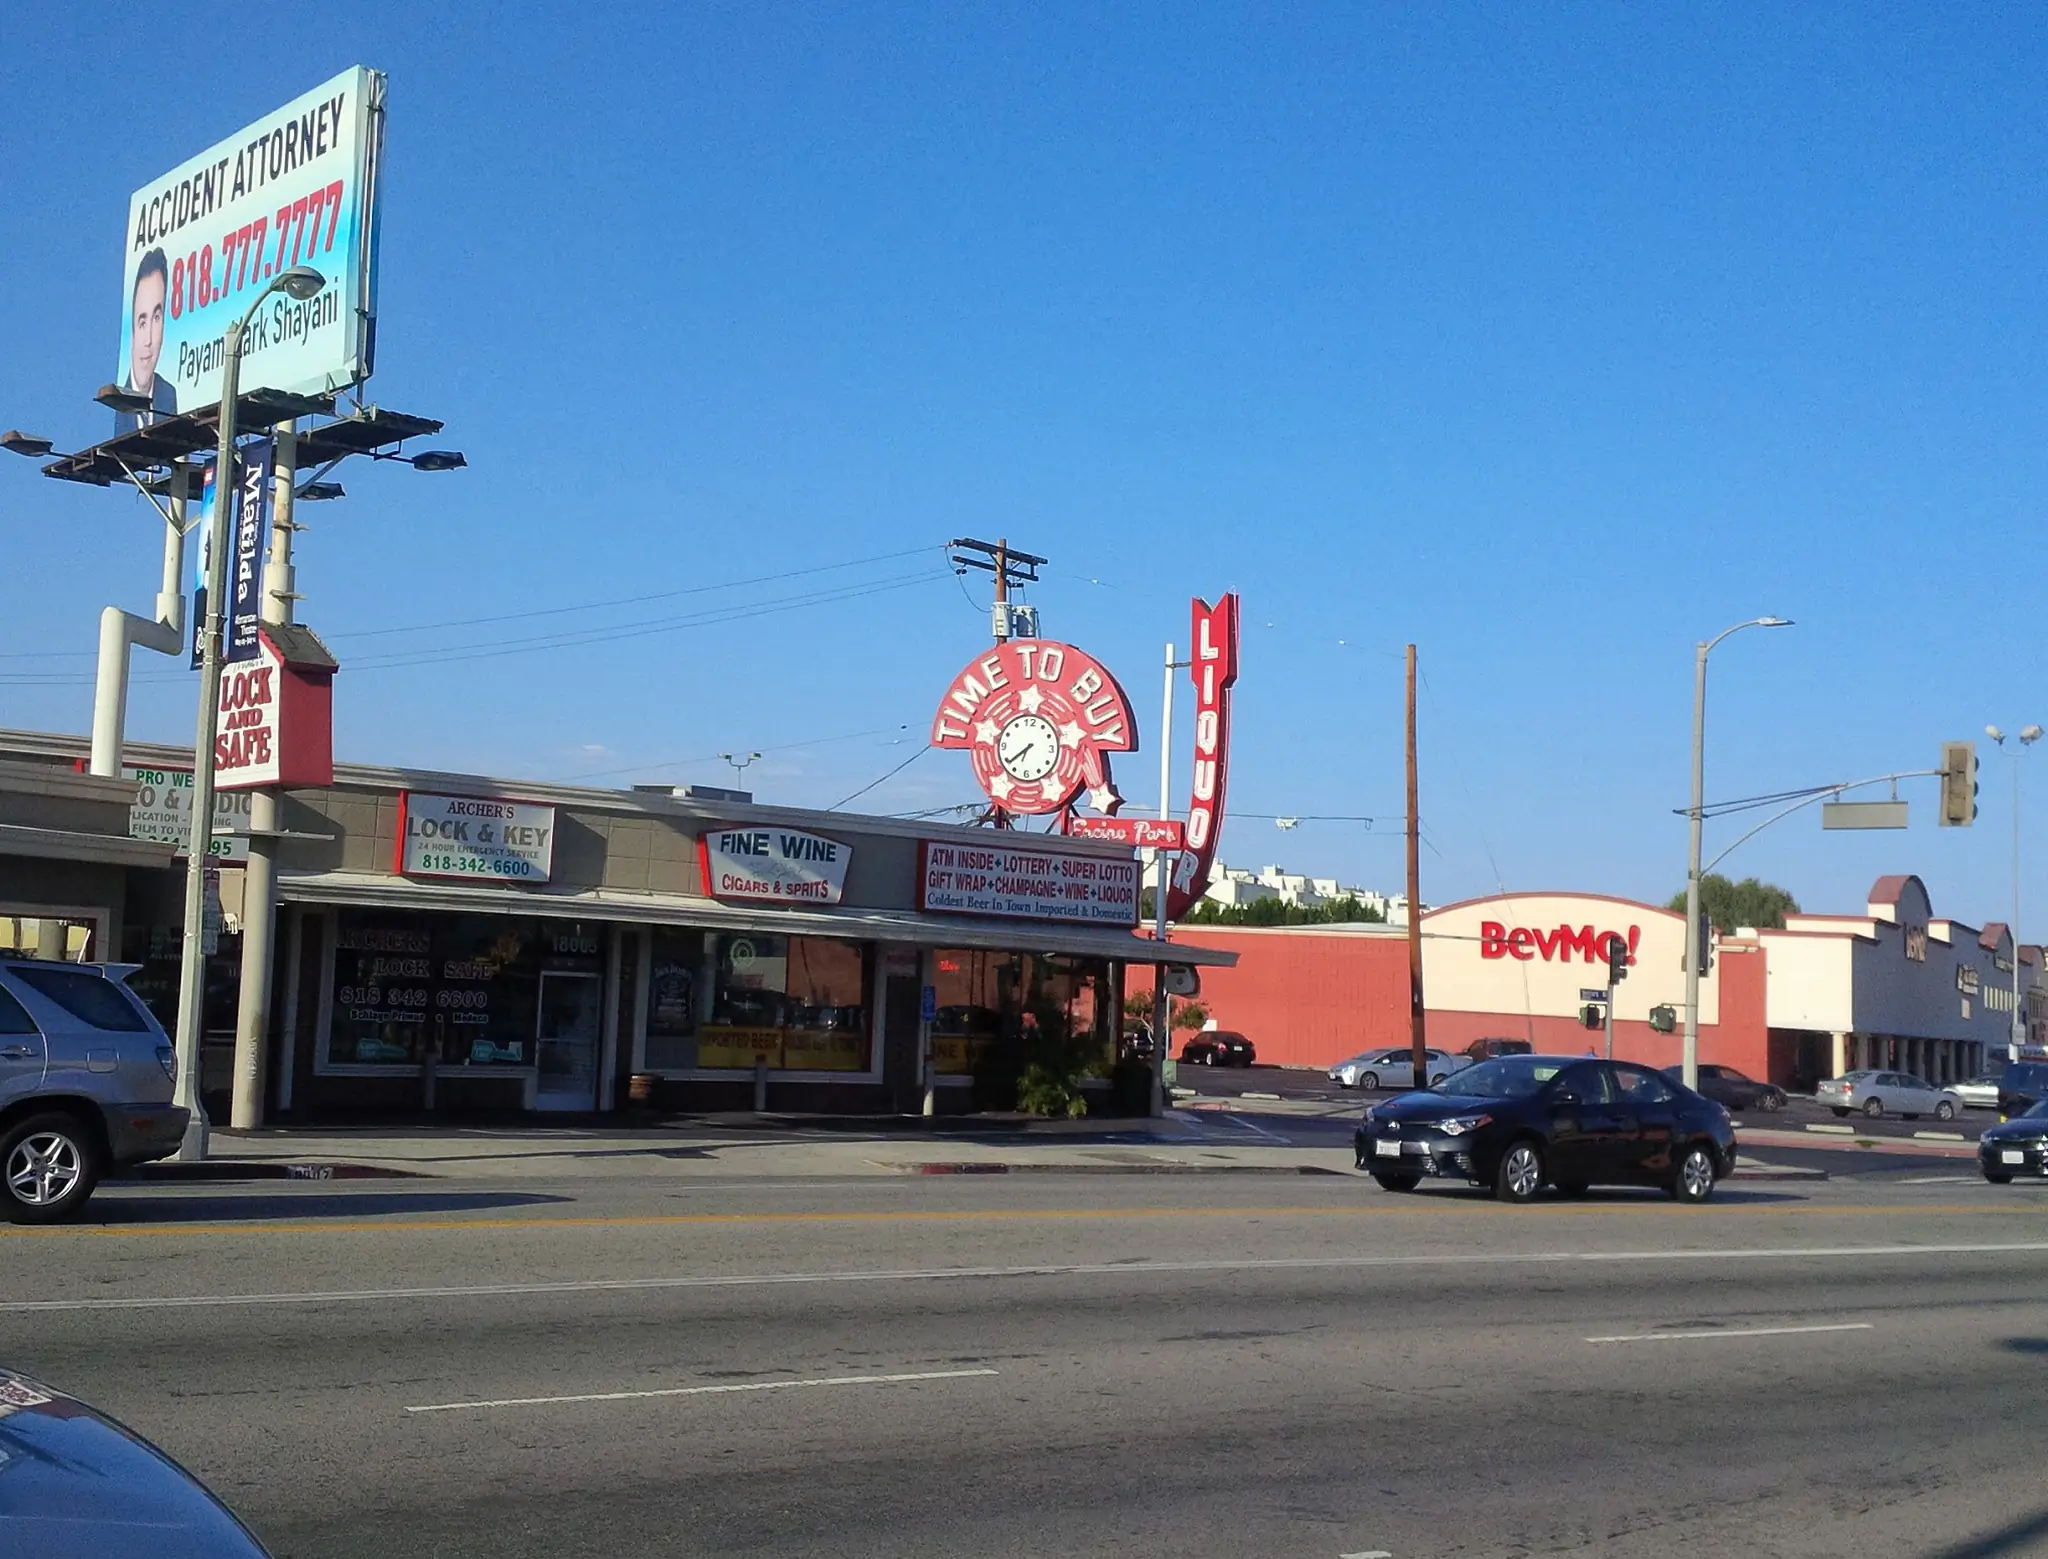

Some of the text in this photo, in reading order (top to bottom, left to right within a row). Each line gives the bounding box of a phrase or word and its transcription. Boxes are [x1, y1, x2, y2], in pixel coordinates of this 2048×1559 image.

[134, 92, 345, 251] ACCIDENT ATTORNEY
[170, 180, 344, 321] 818.777.7777
[177, 335, 225, 388] Payam
[273, 276, 339, 346] Shayani
[237, 463, 263, 604] Matilda
[220, 666, 273, 712] LOCK
[936, 645, 1125, 746] TIME TO BUY
[225, 708, 264, 730] AND
[1024, 718, 1036, 727] 12
[214, 726, 272, 771] SAFE
[1001, 742, 1007, 751] 9
[1048, 745, 1055, 754] 3
[1174, 618, 1219, 894] LIQUOR
[136, 769, 195, 788] PRO WE
[1023, 769, 1030, 779] 6
[447, 801, 515, 819] ARCHER'S
[132, 824, 157, 834] FILM
[161, 826, 174, 835] TO
[407, 816, 551, 847] LOCK & KEY
[1133, 821, 1177, 845] Park
[432, 843, 455, 852] HOUR
[457, 845, 504, 857] EMERGENCY
[507, 850, 539, 859] SERVICE
[720, 833, 837, 862] FINE WINE
[422, 854, 530, 876] 818-342-6600
[931, 848, 1133, 884] ATM INSIDE LOTTERY SUPER LOTTO
[722, 873, 829, 898] CIGARS & SPRITS
[928, 871, 1133, 904] GIFT WRAP CHAMPAGNE WINE LIQUOR
[928, 892, 964, 908] Coldest
[967, 895, 989, 909] Beer
[992, 897, 1003, 910] In
[1006, 899, 1031, 912] Town
[1035, 900, 1079, 917] Imported
[1092, 907, 1133, 921] Domestic
[374, 957, 430, 978] LOCK
[340, 985, 381, 1005] 818
[436, 989, 488, 1009] 6600
